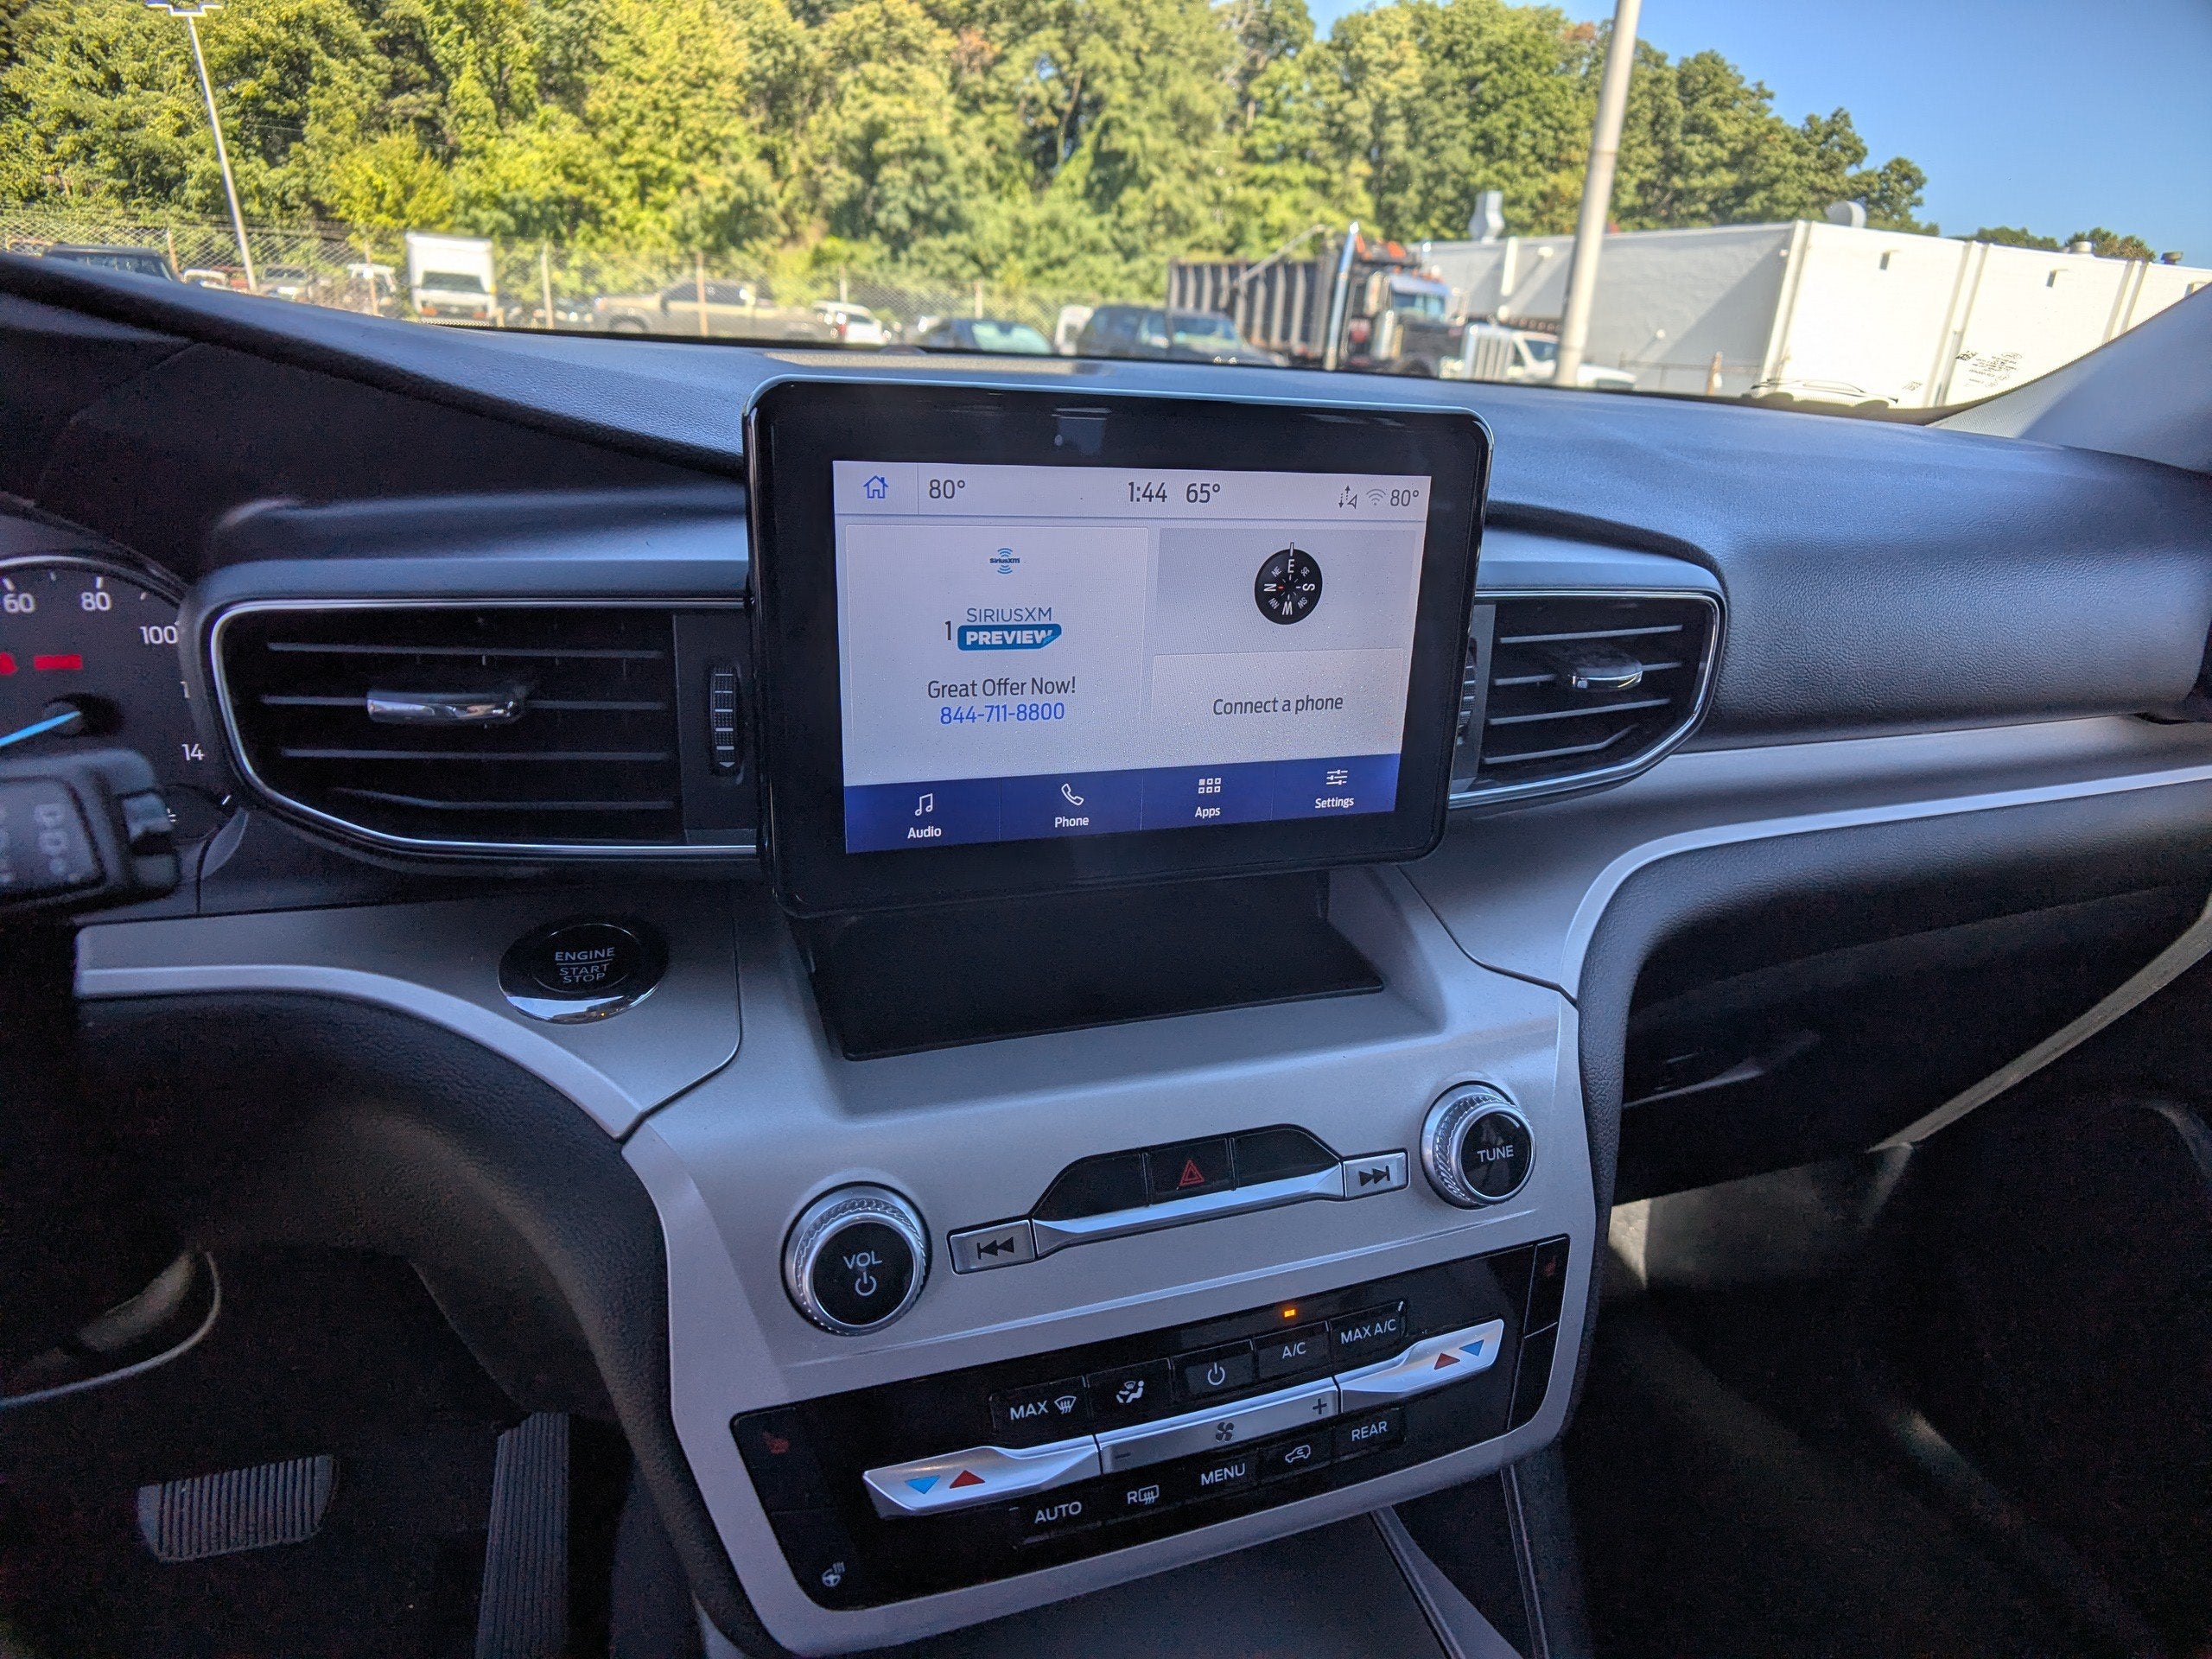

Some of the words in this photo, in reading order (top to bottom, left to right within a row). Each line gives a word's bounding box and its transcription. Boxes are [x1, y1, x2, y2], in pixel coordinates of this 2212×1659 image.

[928, 479, 966, 499] 80°
[1128, 481, 1167, 503] 1:44
[1185, 482, 1221, 504] 65°
[1389, 489, 1420, 507] 80°
[3, 592, 35, 613] 60
[81, 591, 112, 612] 80
[965, 607, 1053, 623] SIRIUSXM
[140, 625, 179, 645] 100
[944, 620, 952, 641] 1
[965, 629, 1054, 646] PREVIEW
[927, 680, 978, 699] Great
[982, 678, 1027, 697] Offer
[1031, 677, 1077, 695] Now!
[939, 702, 1066, 725] 844-711-8800
[1213, 696, 1279, 715] Connect
[1281, 700, 1292, 712] a
[1294, 695, 1344, 715] phone
[181, 743, 205, 761] 14
[1195, 805, 1221, 819] Apps
[1314, 796, 1355, 810] Settings
[1054, 815, 1090, 829] Phone
[907, 825, 943, 840] Audio
[555, 948, 614, 961] ENGINE
[559, 963, 610, 976] START
[563, 973, 605, 983] STOP
[1477, 1144, 1515, 1162] TUNE
[843, 1249, 883, 1270] VOL
[1340, 1325, 1371, 1344] MAX
[1373, 1319, 1397, 1334] A/C
[1281, 1341, 1306, 1359] A/C
[1009, 1400, 1049, 1421] MAX
[1351, 1421, 1388, 1441] REAR
[1200, 1463, 1246, 1486] MENU
[1033, 1501, 1082, 1525] AUTO
